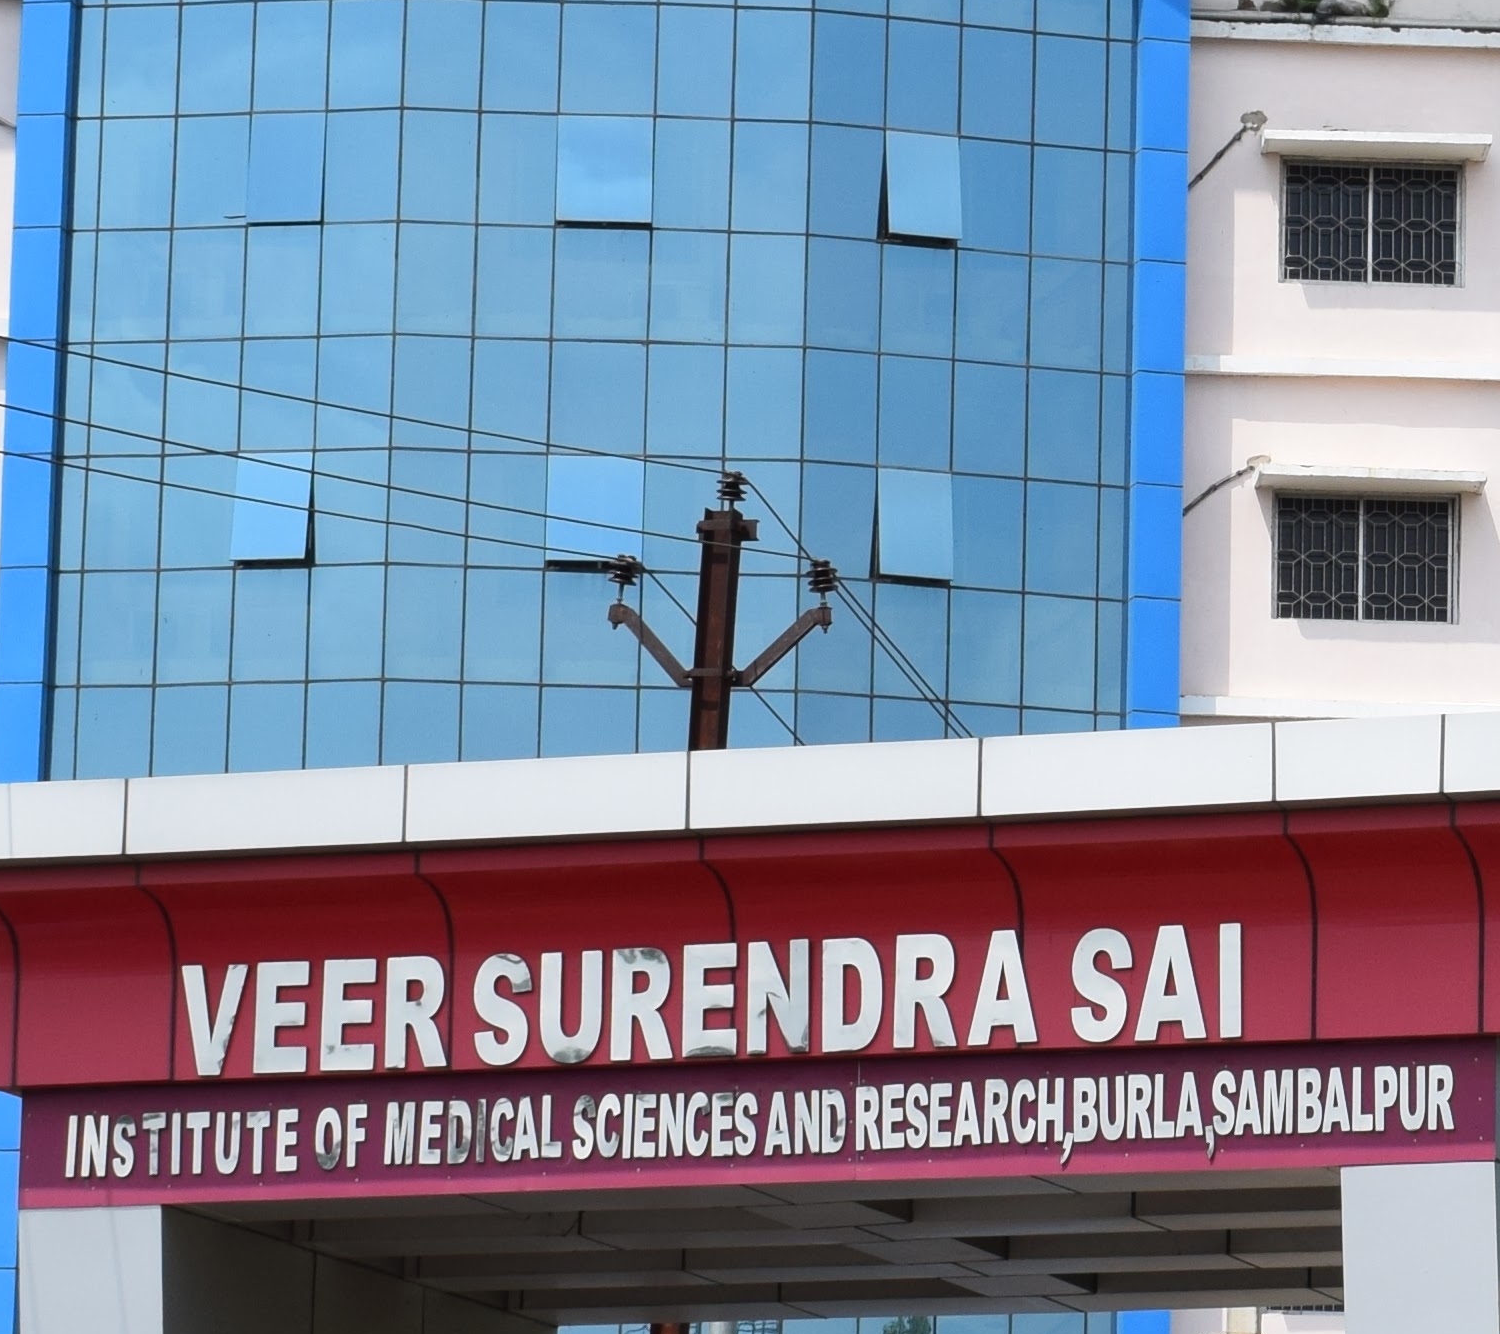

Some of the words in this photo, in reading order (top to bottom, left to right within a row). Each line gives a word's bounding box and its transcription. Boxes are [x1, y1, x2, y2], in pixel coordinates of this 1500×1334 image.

[181, 955, 449, 1077] VEER
[472, 928, 1039, 1067] SURENDRA
[1070, 922, 1243, 1044] SAI
[64, 1107, 300, 1179] INSTITUTE
[315, 1102, 368, 1171] OF
[383, 1094, 562, 1166] MEDICAL
[572, 1091, 758, 1161] SCIENCES
[763, 1089, 846, 1156] AND
